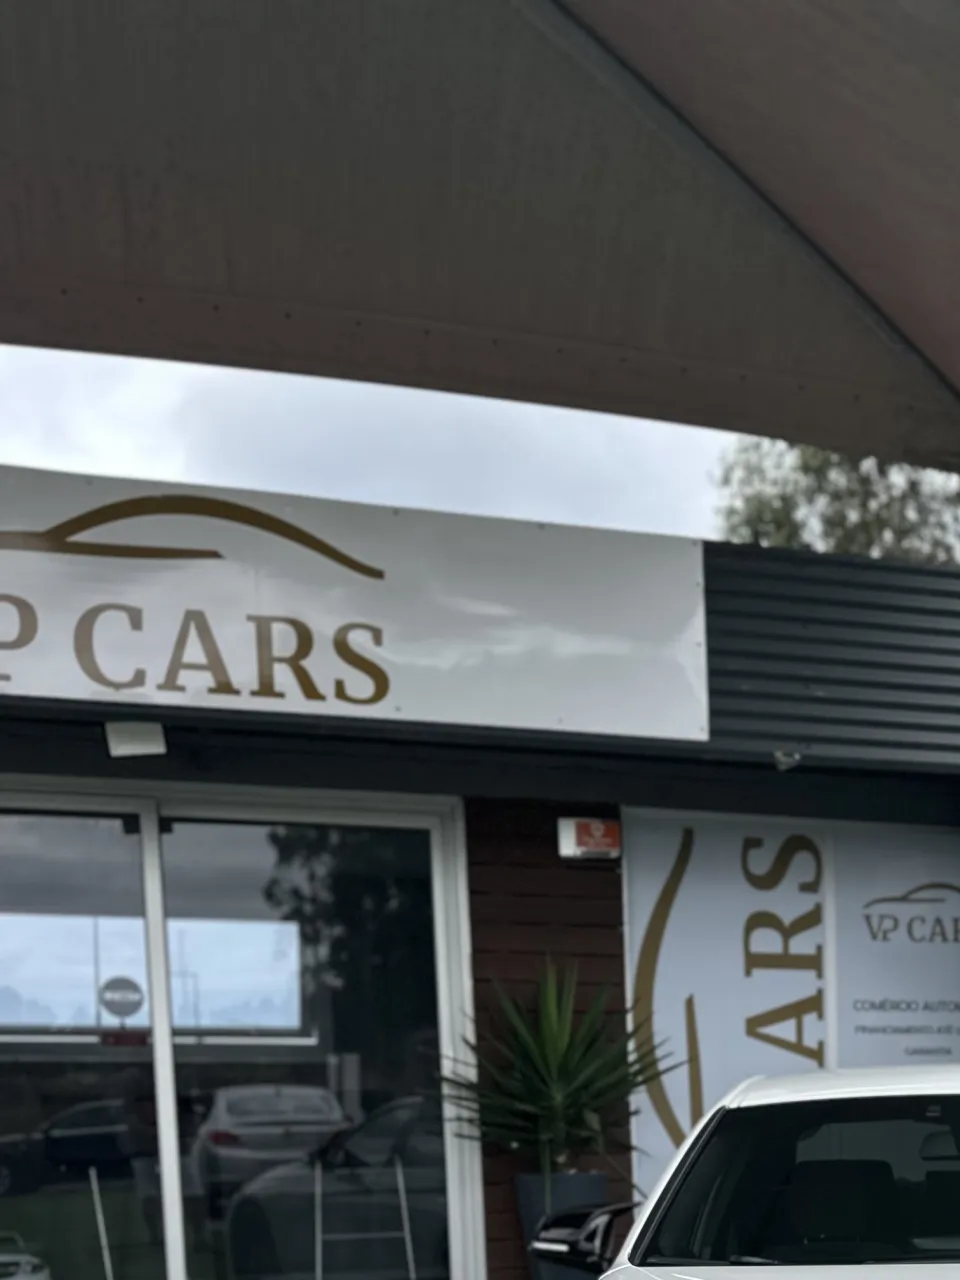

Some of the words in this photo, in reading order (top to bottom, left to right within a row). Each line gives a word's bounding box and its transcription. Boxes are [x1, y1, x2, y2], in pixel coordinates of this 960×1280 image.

[73, 602, 390, 705] CARS
[741, 833, 824, 1069] ARS
[863, 914, 899, 942] VP
